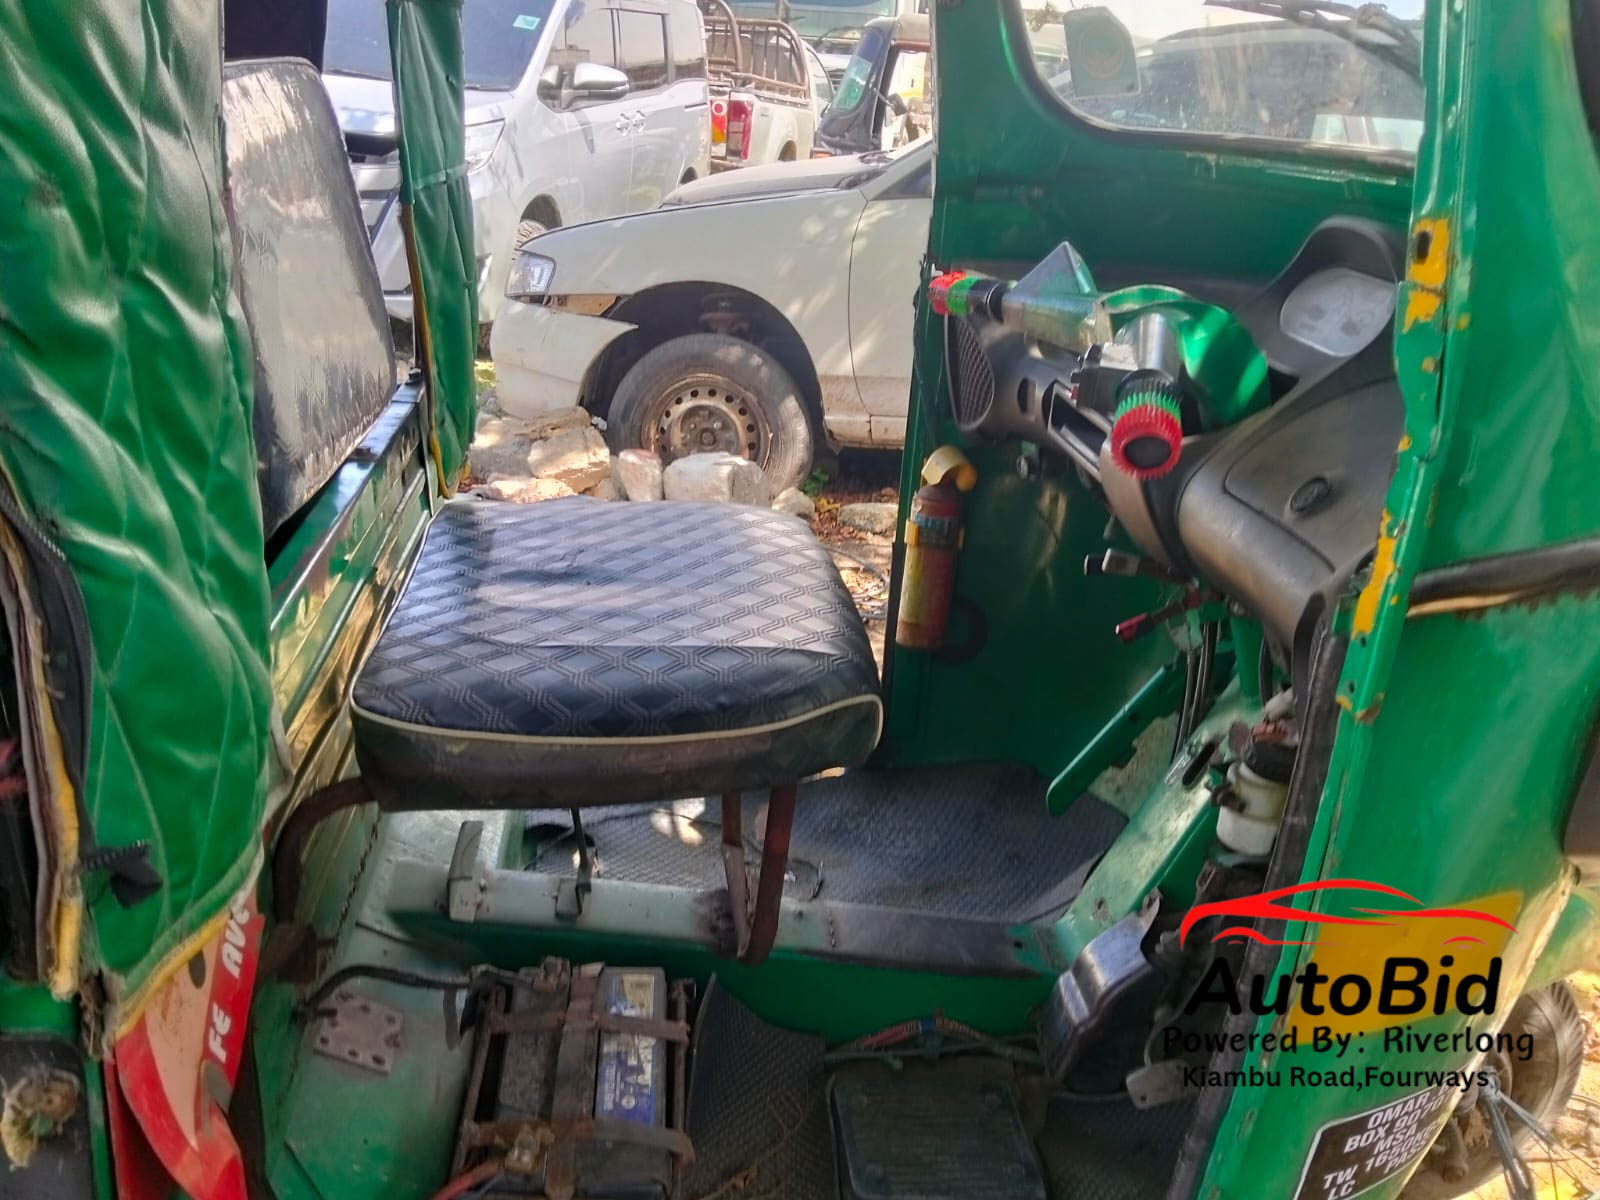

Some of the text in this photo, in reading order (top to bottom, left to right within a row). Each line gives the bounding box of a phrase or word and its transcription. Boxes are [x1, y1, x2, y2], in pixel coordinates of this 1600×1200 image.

[1367, 1091, 1431, 1130] OMAR
[1344, 1123, 1391, 1153] BOX
[1373, 1122, 1418, 1155] MSA
[1323, 1164, 1359, 1190] TW
[1327, 1179, 1356, 1200] LC
